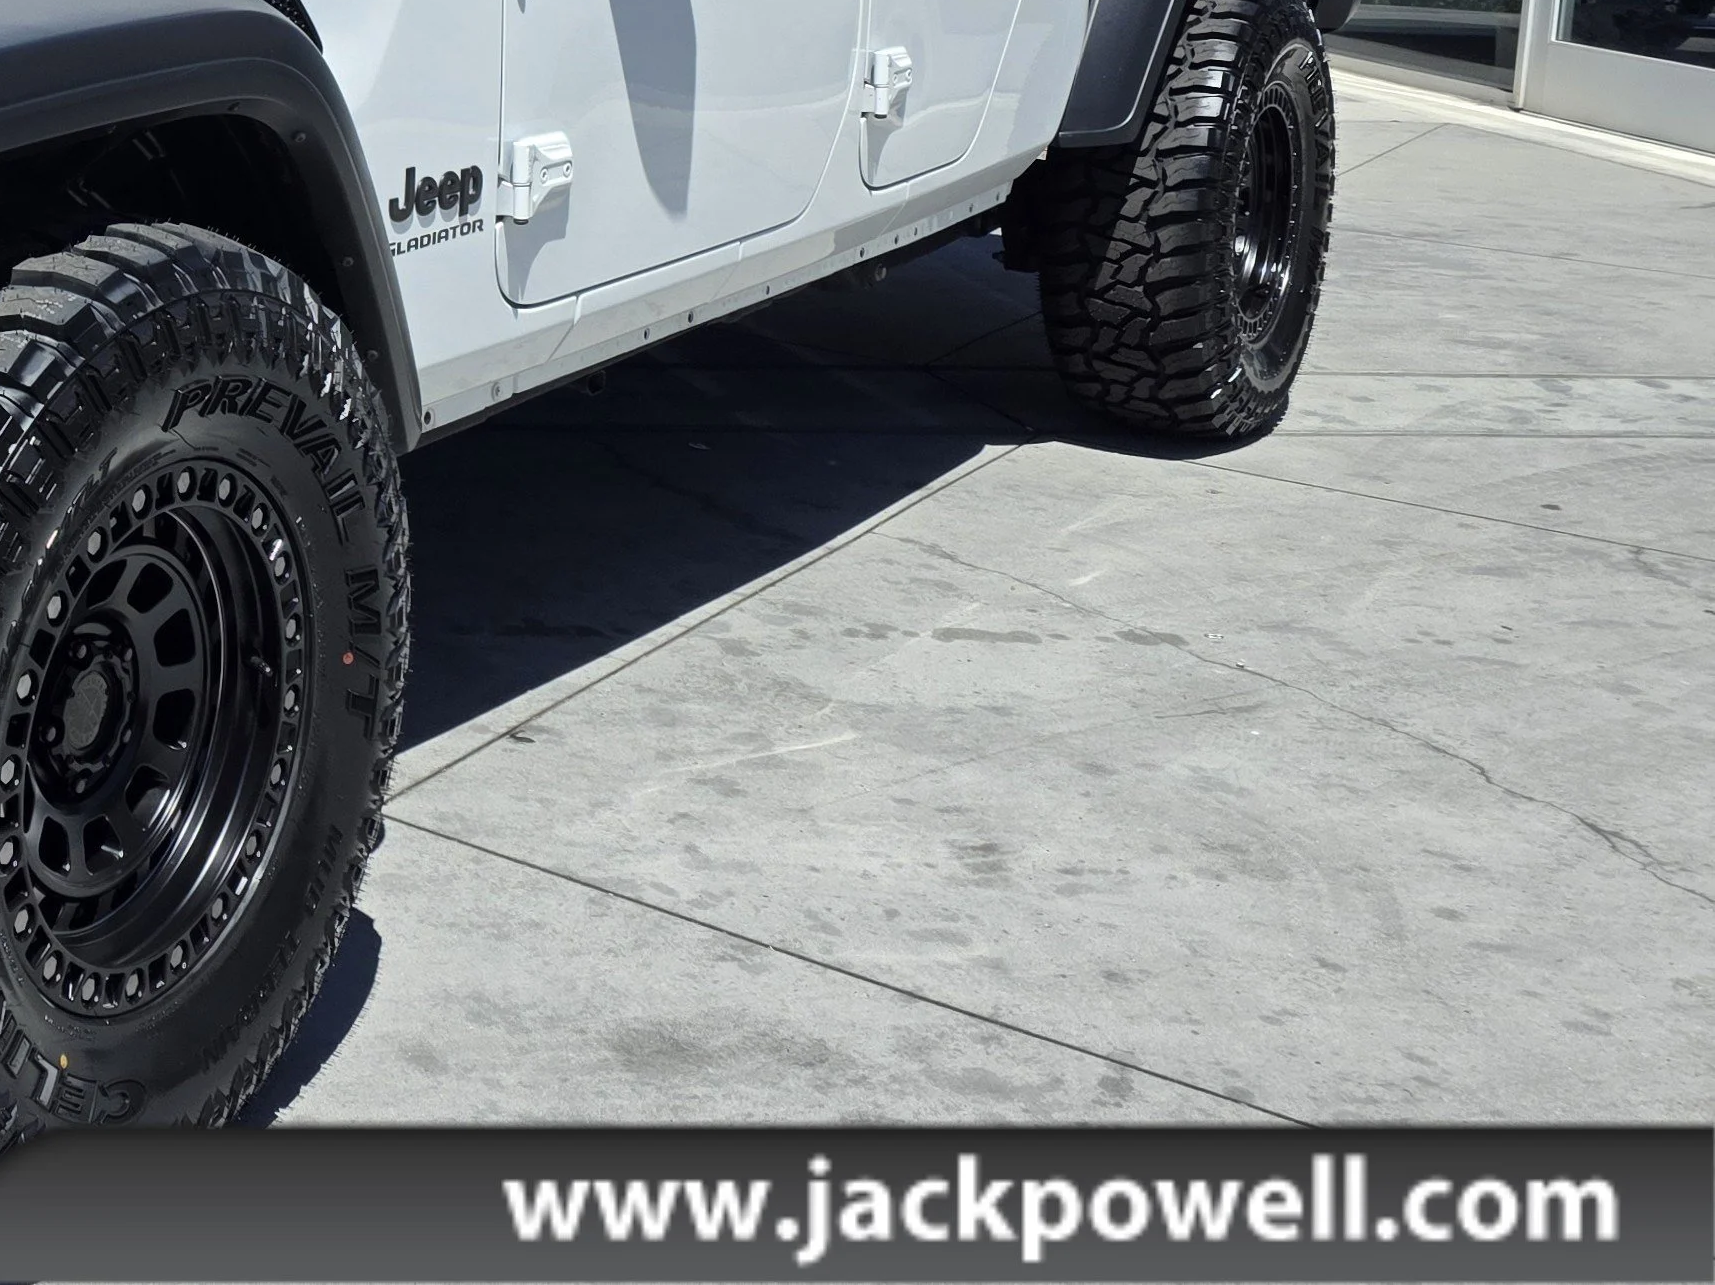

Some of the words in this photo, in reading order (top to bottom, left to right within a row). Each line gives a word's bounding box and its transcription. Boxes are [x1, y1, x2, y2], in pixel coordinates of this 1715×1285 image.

[389, 165, 484, 222] Jeep
[161, 374, 367, 546] PREVAIL
[344, 566, 382, 741] M/T
